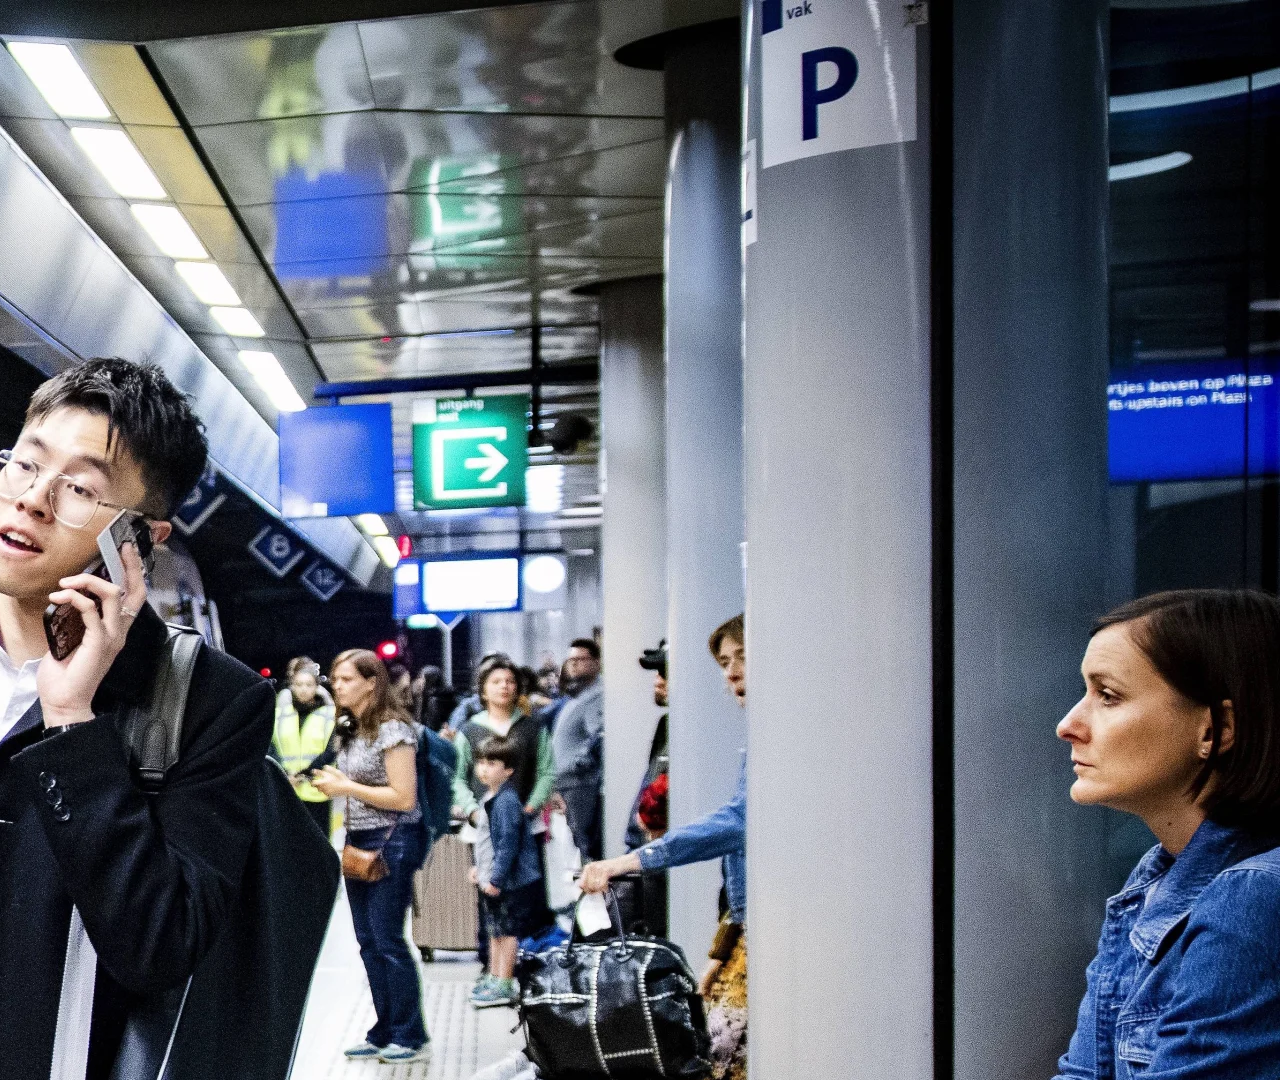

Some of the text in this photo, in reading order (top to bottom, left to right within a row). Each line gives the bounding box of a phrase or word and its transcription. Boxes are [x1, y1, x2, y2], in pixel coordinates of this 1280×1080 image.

[786, 1, 813, 20] vak
[801, 45, 860, 142] P
[1147, 379, 1200, 393] boven
[1202, 377, 1226, 391] op
[439, 399, 484, 412] uitgang
[1185, 394, 1208, 407] on
